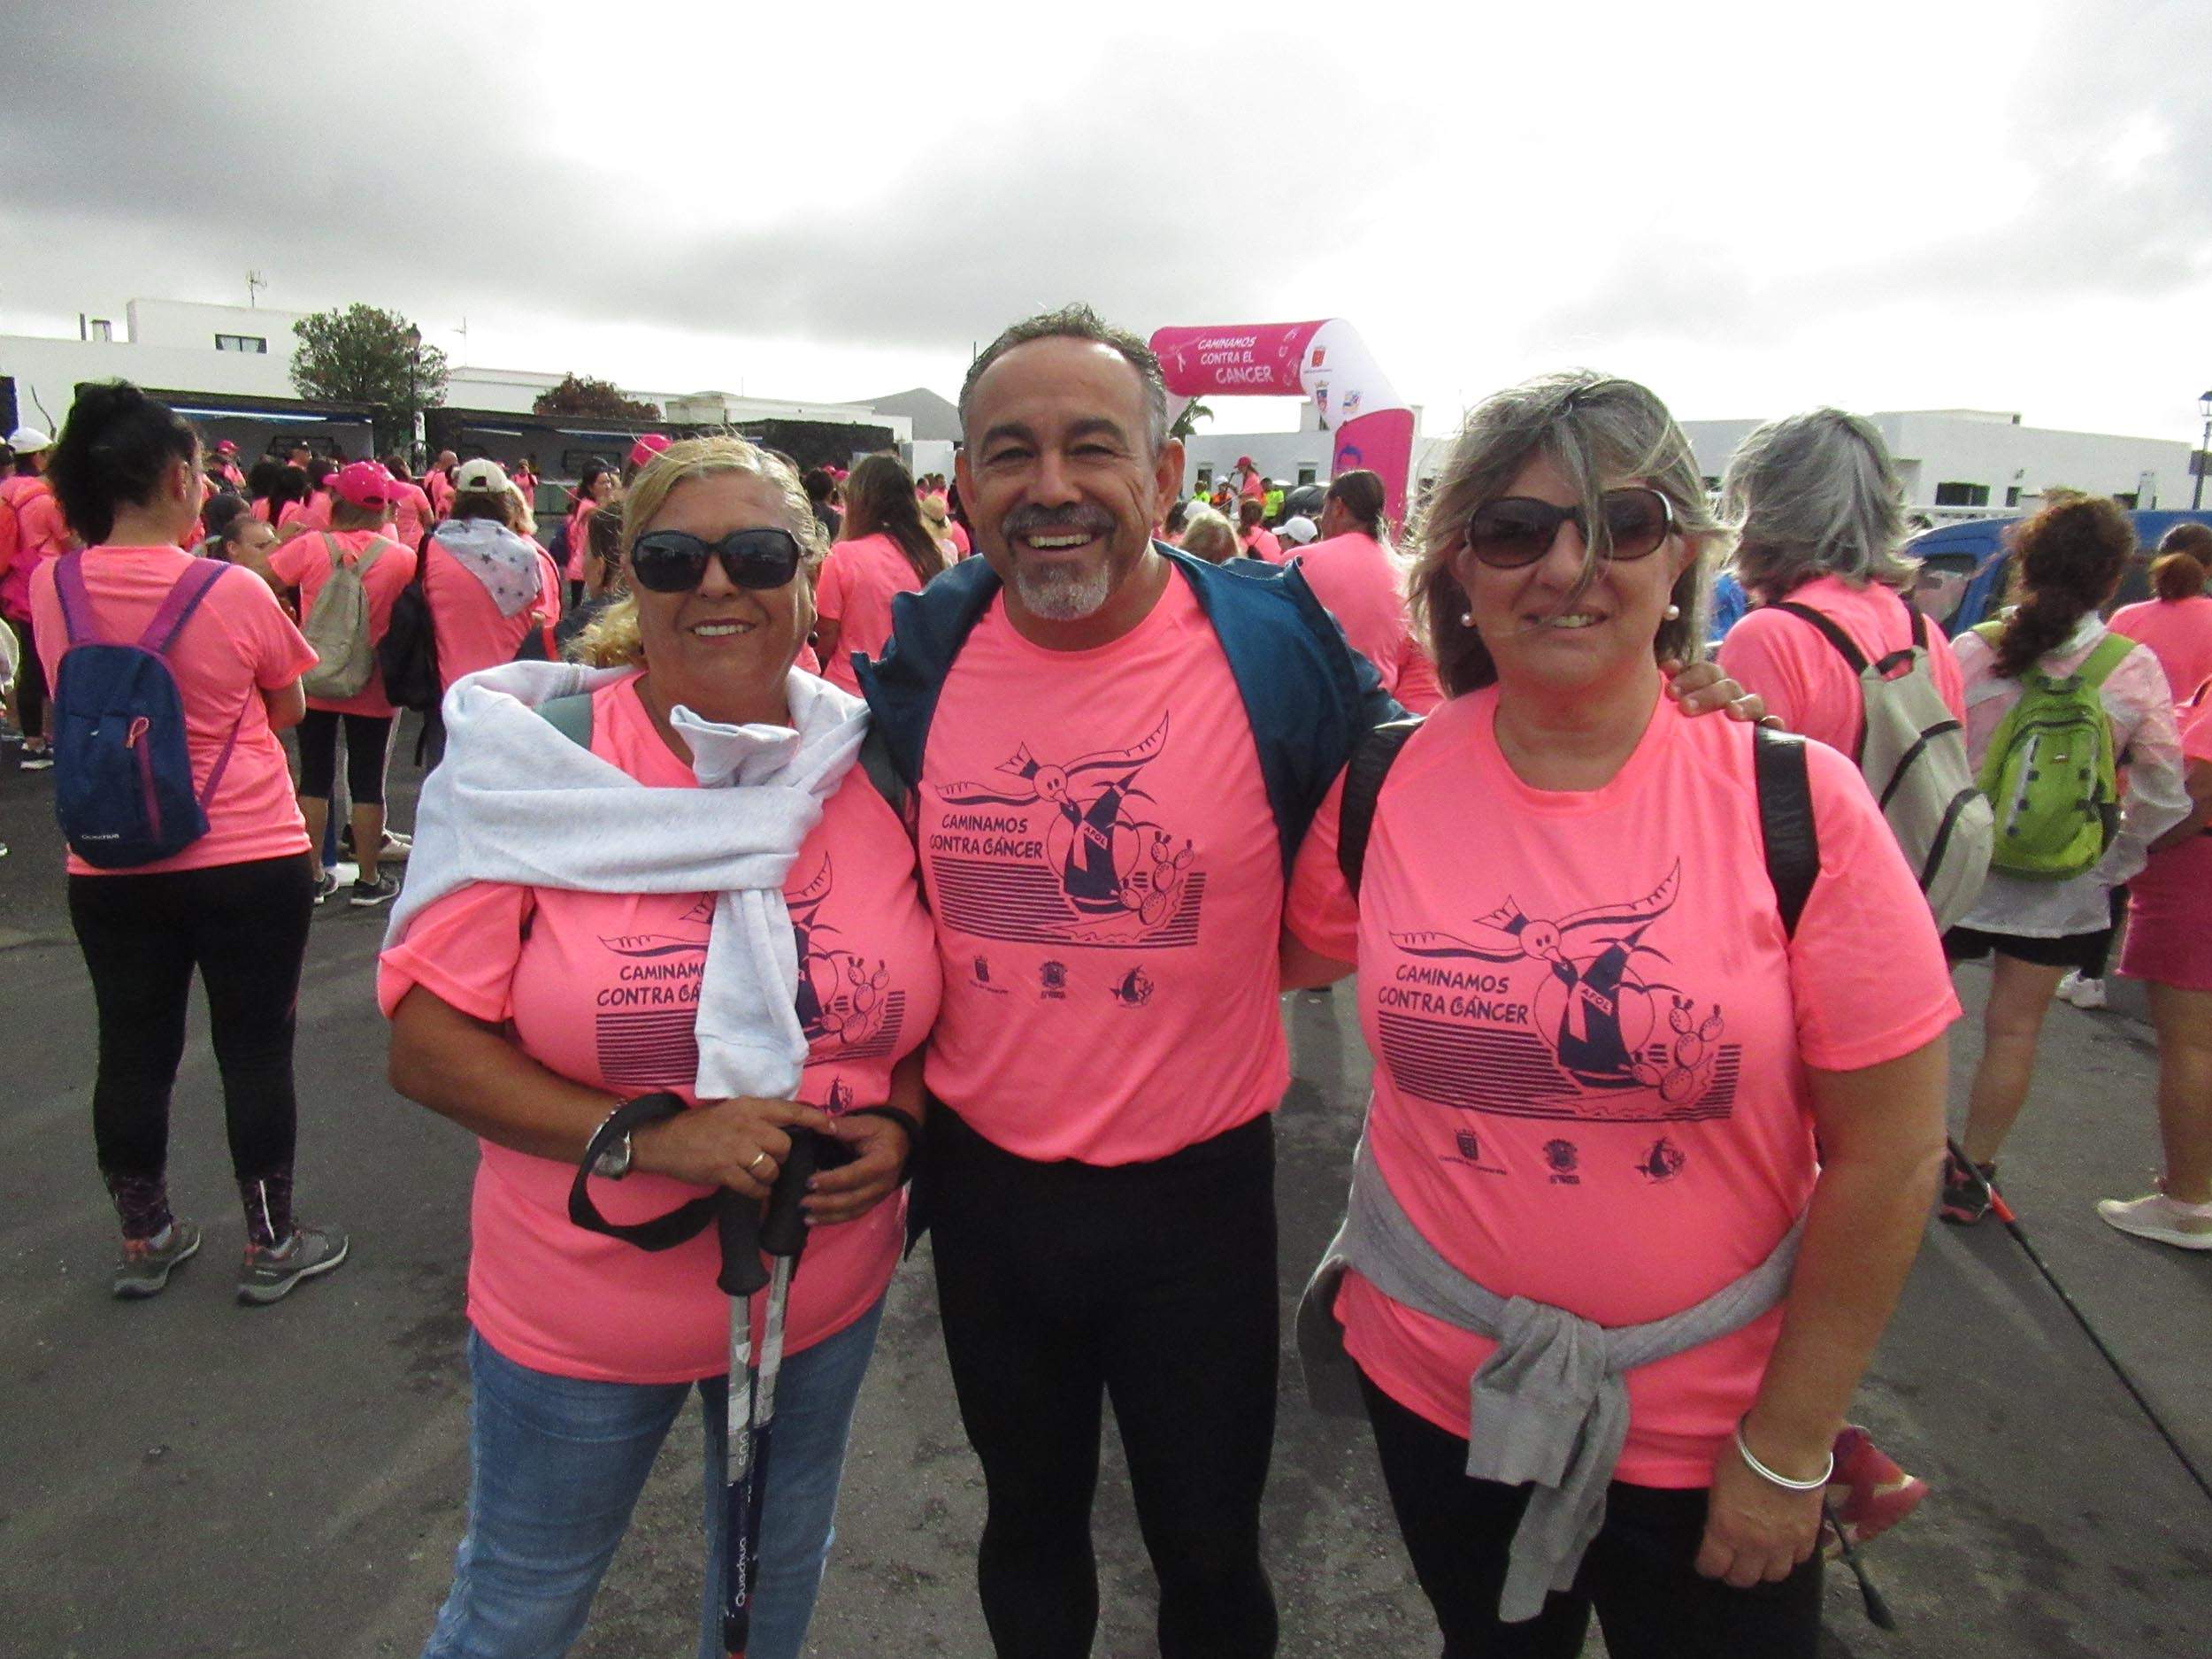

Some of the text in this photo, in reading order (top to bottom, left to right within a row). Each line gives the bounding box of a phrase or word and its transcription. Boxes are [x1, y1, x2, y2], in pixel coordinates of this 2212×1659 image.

[1198, 335, 1257, 350] CAMINAMOS
[1201, 350, 1254, 365] CONTRA EL
[1216, 364, 1274, 384] CANCER
[941, 813, 1028, 833] CAMINAMOS
[929, 834, 980, 855] CONTRA
[1395, 964, 1510, 995] CAMINAMOS
[596, 987, 675, 1007] CONTRA
[1379, 986, 1446, 1015] CONTRA
